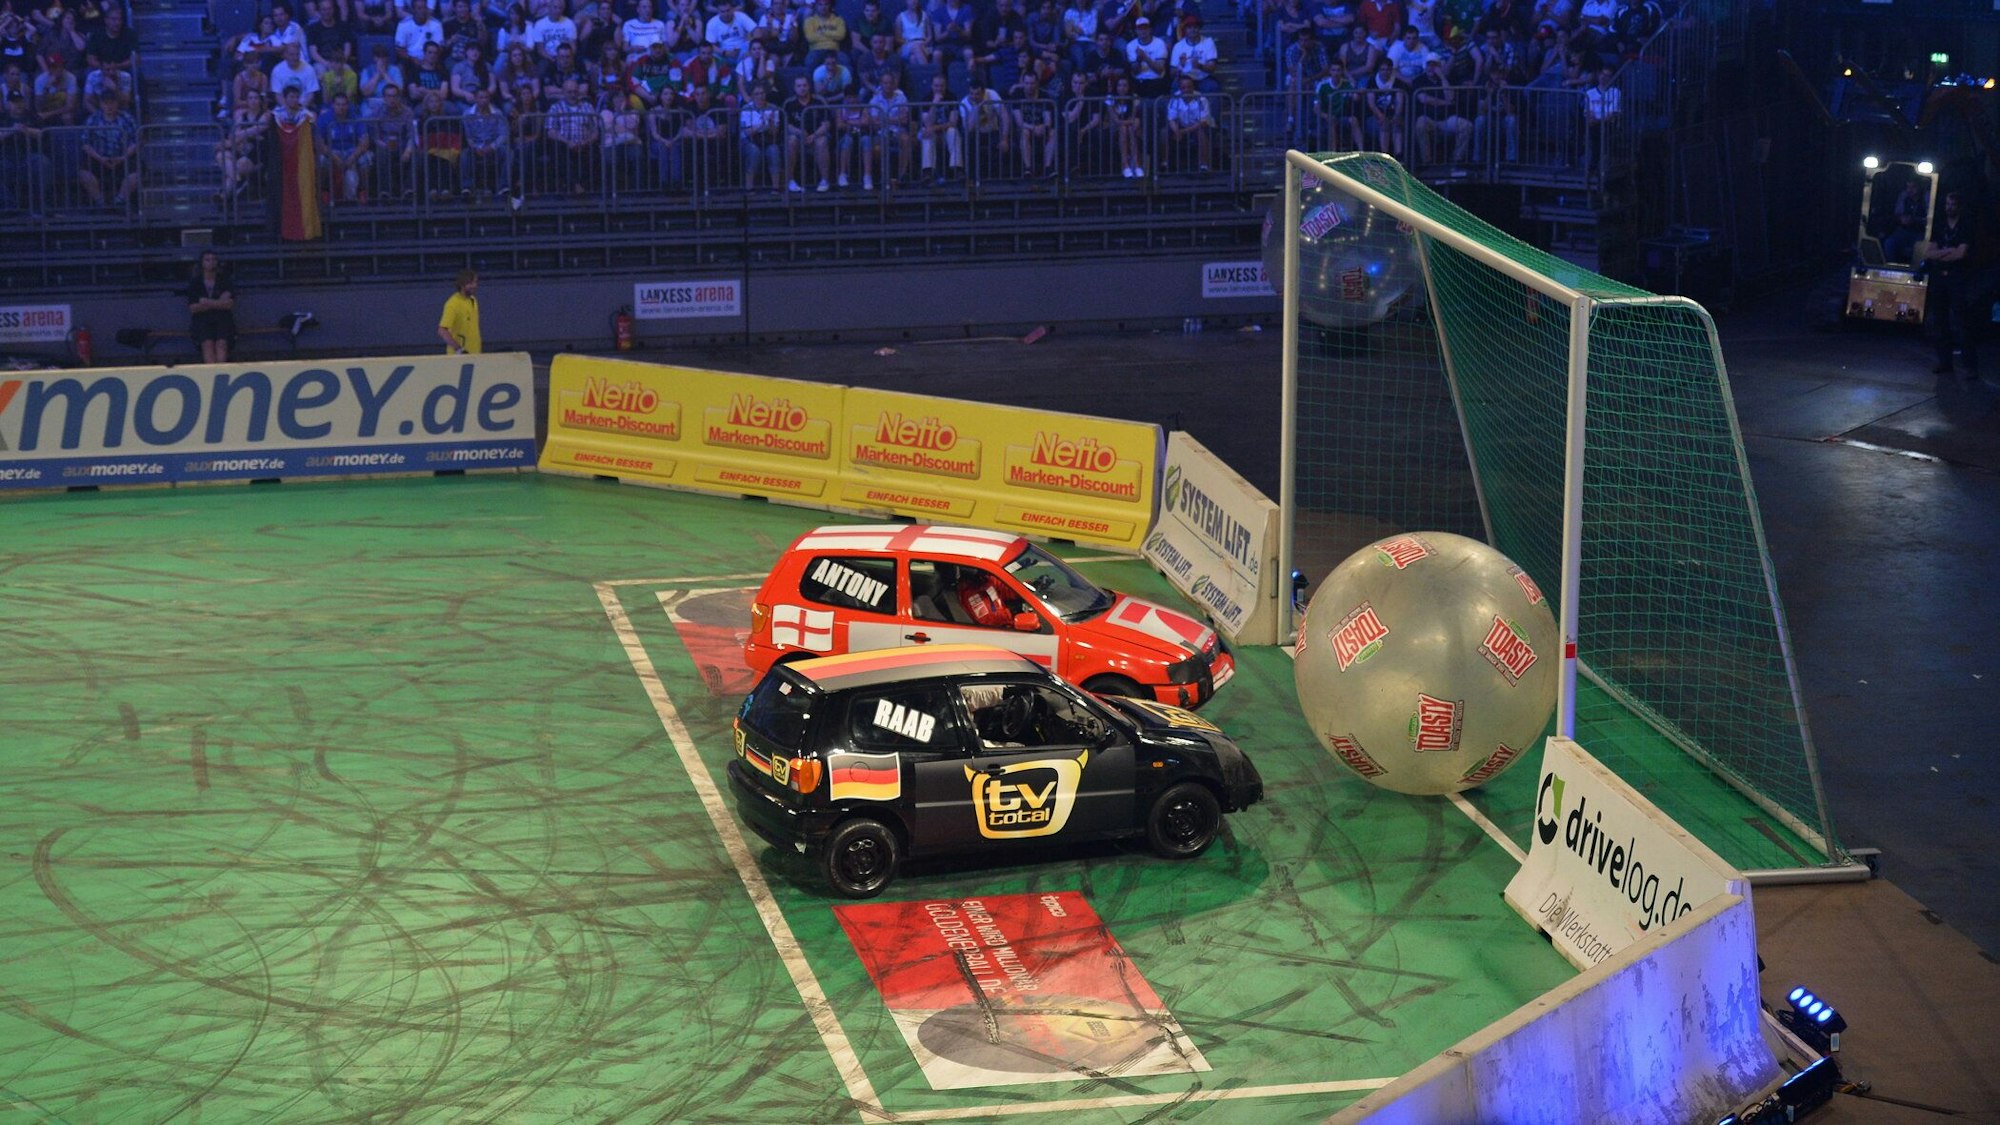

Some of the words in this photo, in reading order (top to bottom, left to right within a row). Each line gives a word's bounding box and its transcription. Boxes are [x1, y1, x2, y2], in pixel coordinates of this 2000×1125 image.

[1302, 203, 1340, 237] TOASTY
[1208, 267, 1257, 283] LANXESS
[640, 287, 692, 304] LANXESS
[694, 286, 734, 302] arena
[23, 311, 64, 327] arena
[583, 377, 658, 414] Netto
[564, 409, 676, 435] Marken-Discount
[727, 393, 807, 432] Netto
[708, 427, 825, 455] Marken-Discount
[875, 411, 957, 451] Netto
[574, 453, 615, 467] EINFACH
[617, 458, 653, 471] BESSER
[855, 444, 975, 474] Marken-Discount
[1031, 431, 1117, 472] Netto
[719, 471, 761, 485] EINFACH
[763, 476, 802, 490] BESSER
[1010, 465, 1135, 497] Marken-Discount
[866, 491, 910, 505] EINFACH
[911, 496, 951, 510] BESSER
[1021, 512, 1066, 527] EINFACH
[1068, 518, 1109, 534] BESSER
[1180, 478, 1223, 546] SYSTEM
[1224, 515, 1251, 566] LIFT
[1155, 534, 1179, 567] SYSTEM
[1174, 555, 1193, 576] LIFT
[811, 558, 889, 607] ANTONY
[1200, 580, 1227, 612] SYSTEM
[1222, 598, 1242, 623] LIFT
[1333, 611, 1388, 669] TOASTY
[1484, 615, 1537, 677] TOASTY
[873, 698, 936, 743] RAAB
[1417, 694, 1455, 751] TOASTY
[1460, 744, 1515, 784] TOASTY
[984, 779, 1057, 811] tv
[989, 807, 1050, 826] total
[962, 900, 993, 924] EINER
[1539, 892, 1562, 922] Die
[1557, 907, 1613, 964] Werkstatt
[976, 924, 1007, 946] WIRD
